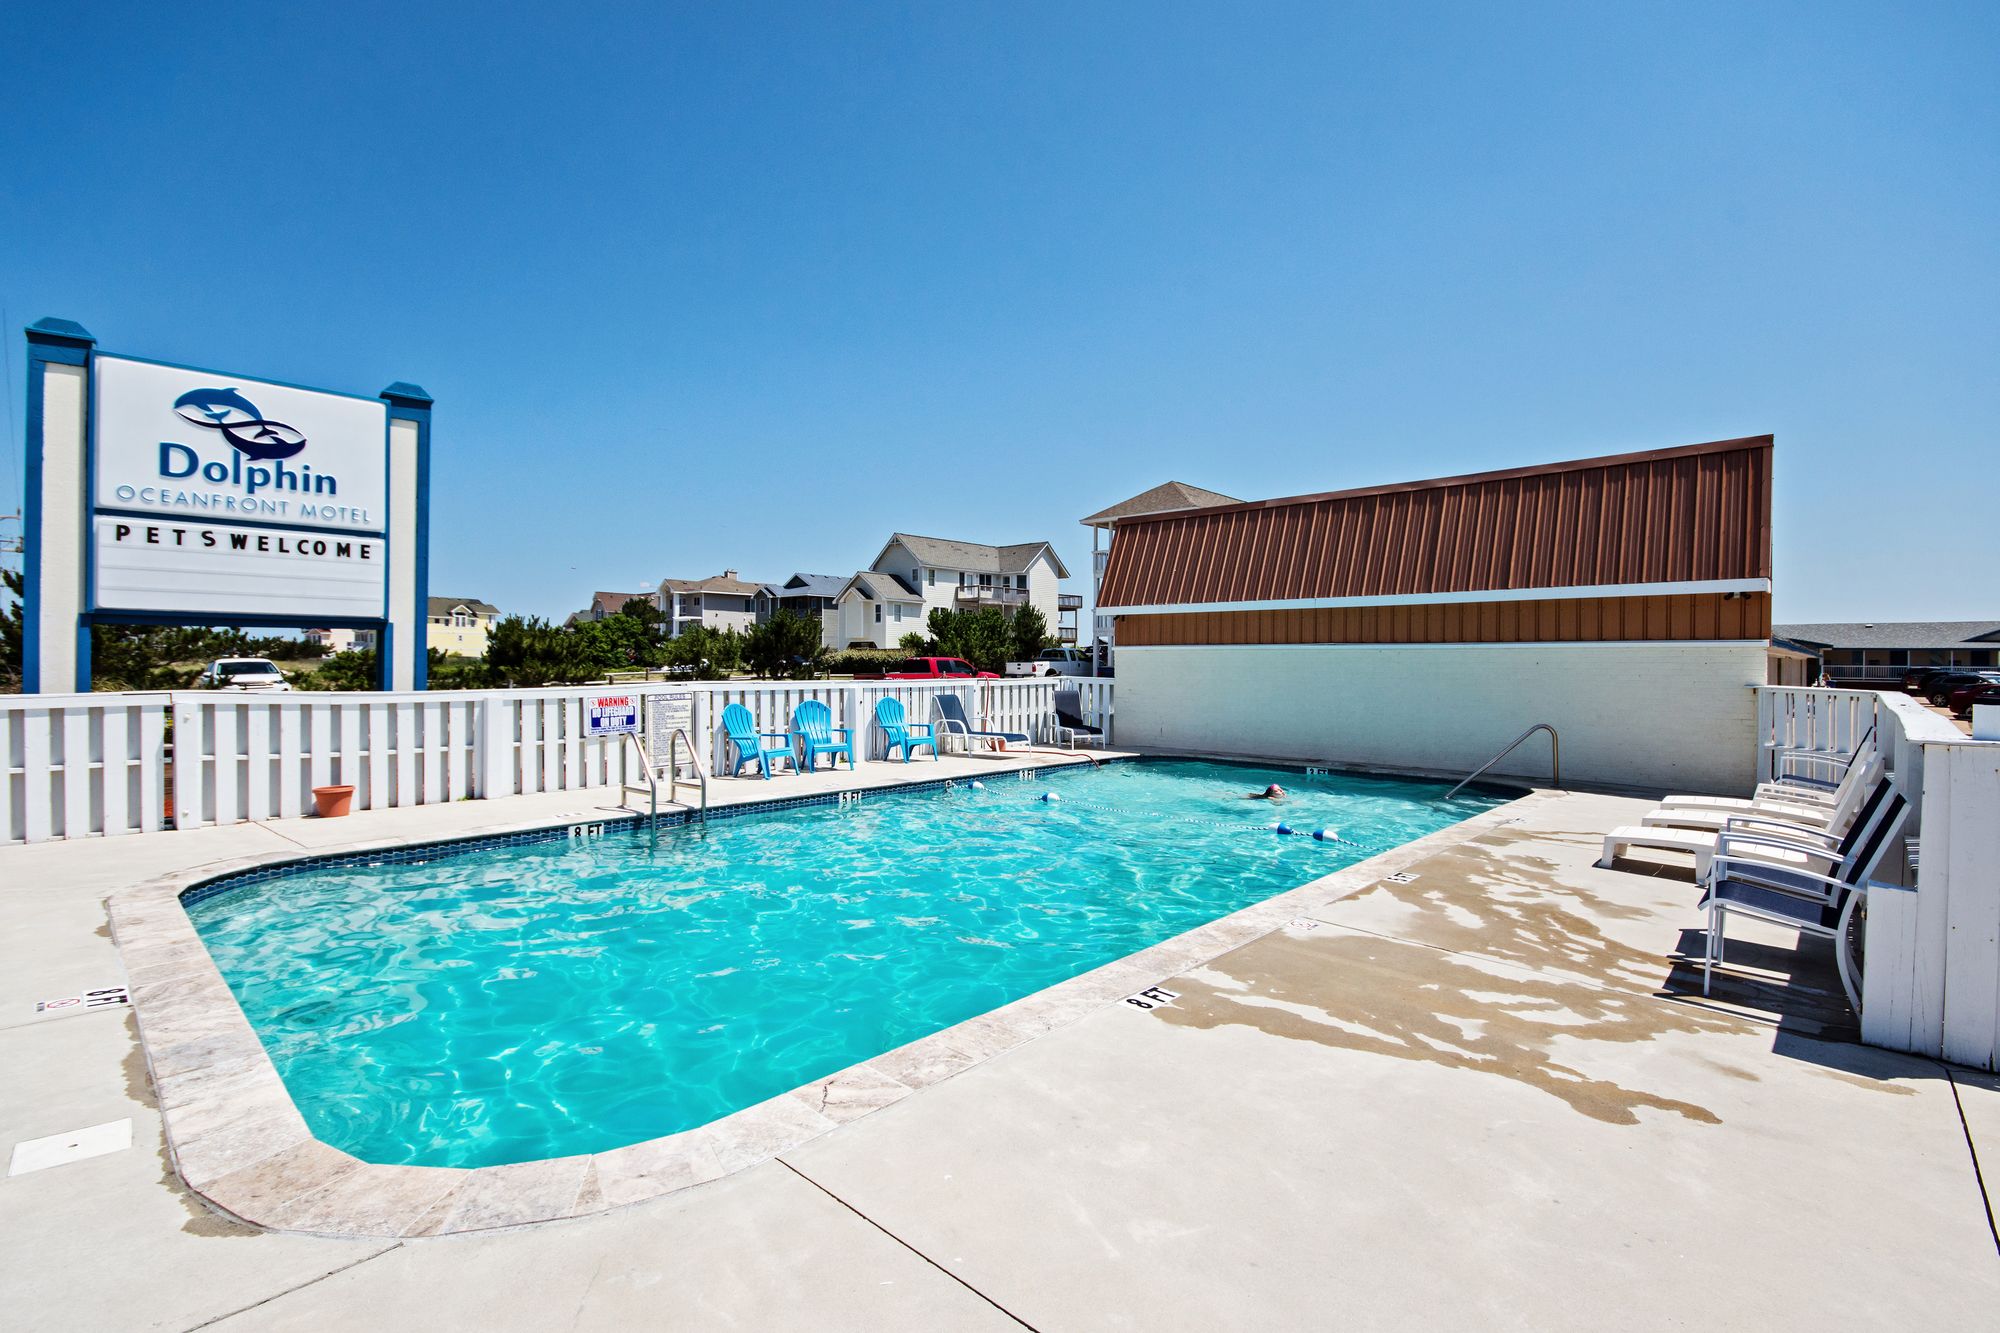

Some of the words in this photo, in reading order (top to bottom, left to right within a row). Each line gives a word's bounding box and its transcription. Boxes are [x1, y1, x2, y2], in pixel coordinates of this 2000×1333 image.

[159, 442, 337, 495] Dolphin
[116, 484, 289, 515] OCEANFRONT
[301, 502, 371, 524] MOTEL
[597, 696, 629, 708] WARNING
[592, 708, 601, 718] NO
[600, 717, 609, 727] ON
[610, 716, 627, 727] DUTY
[850, 791, 861, 803] FT
[587, 823, 602, 838] FT
[1126, 998, 1154, 1009] 8
[1140, 986, 1177, 1003] FT
